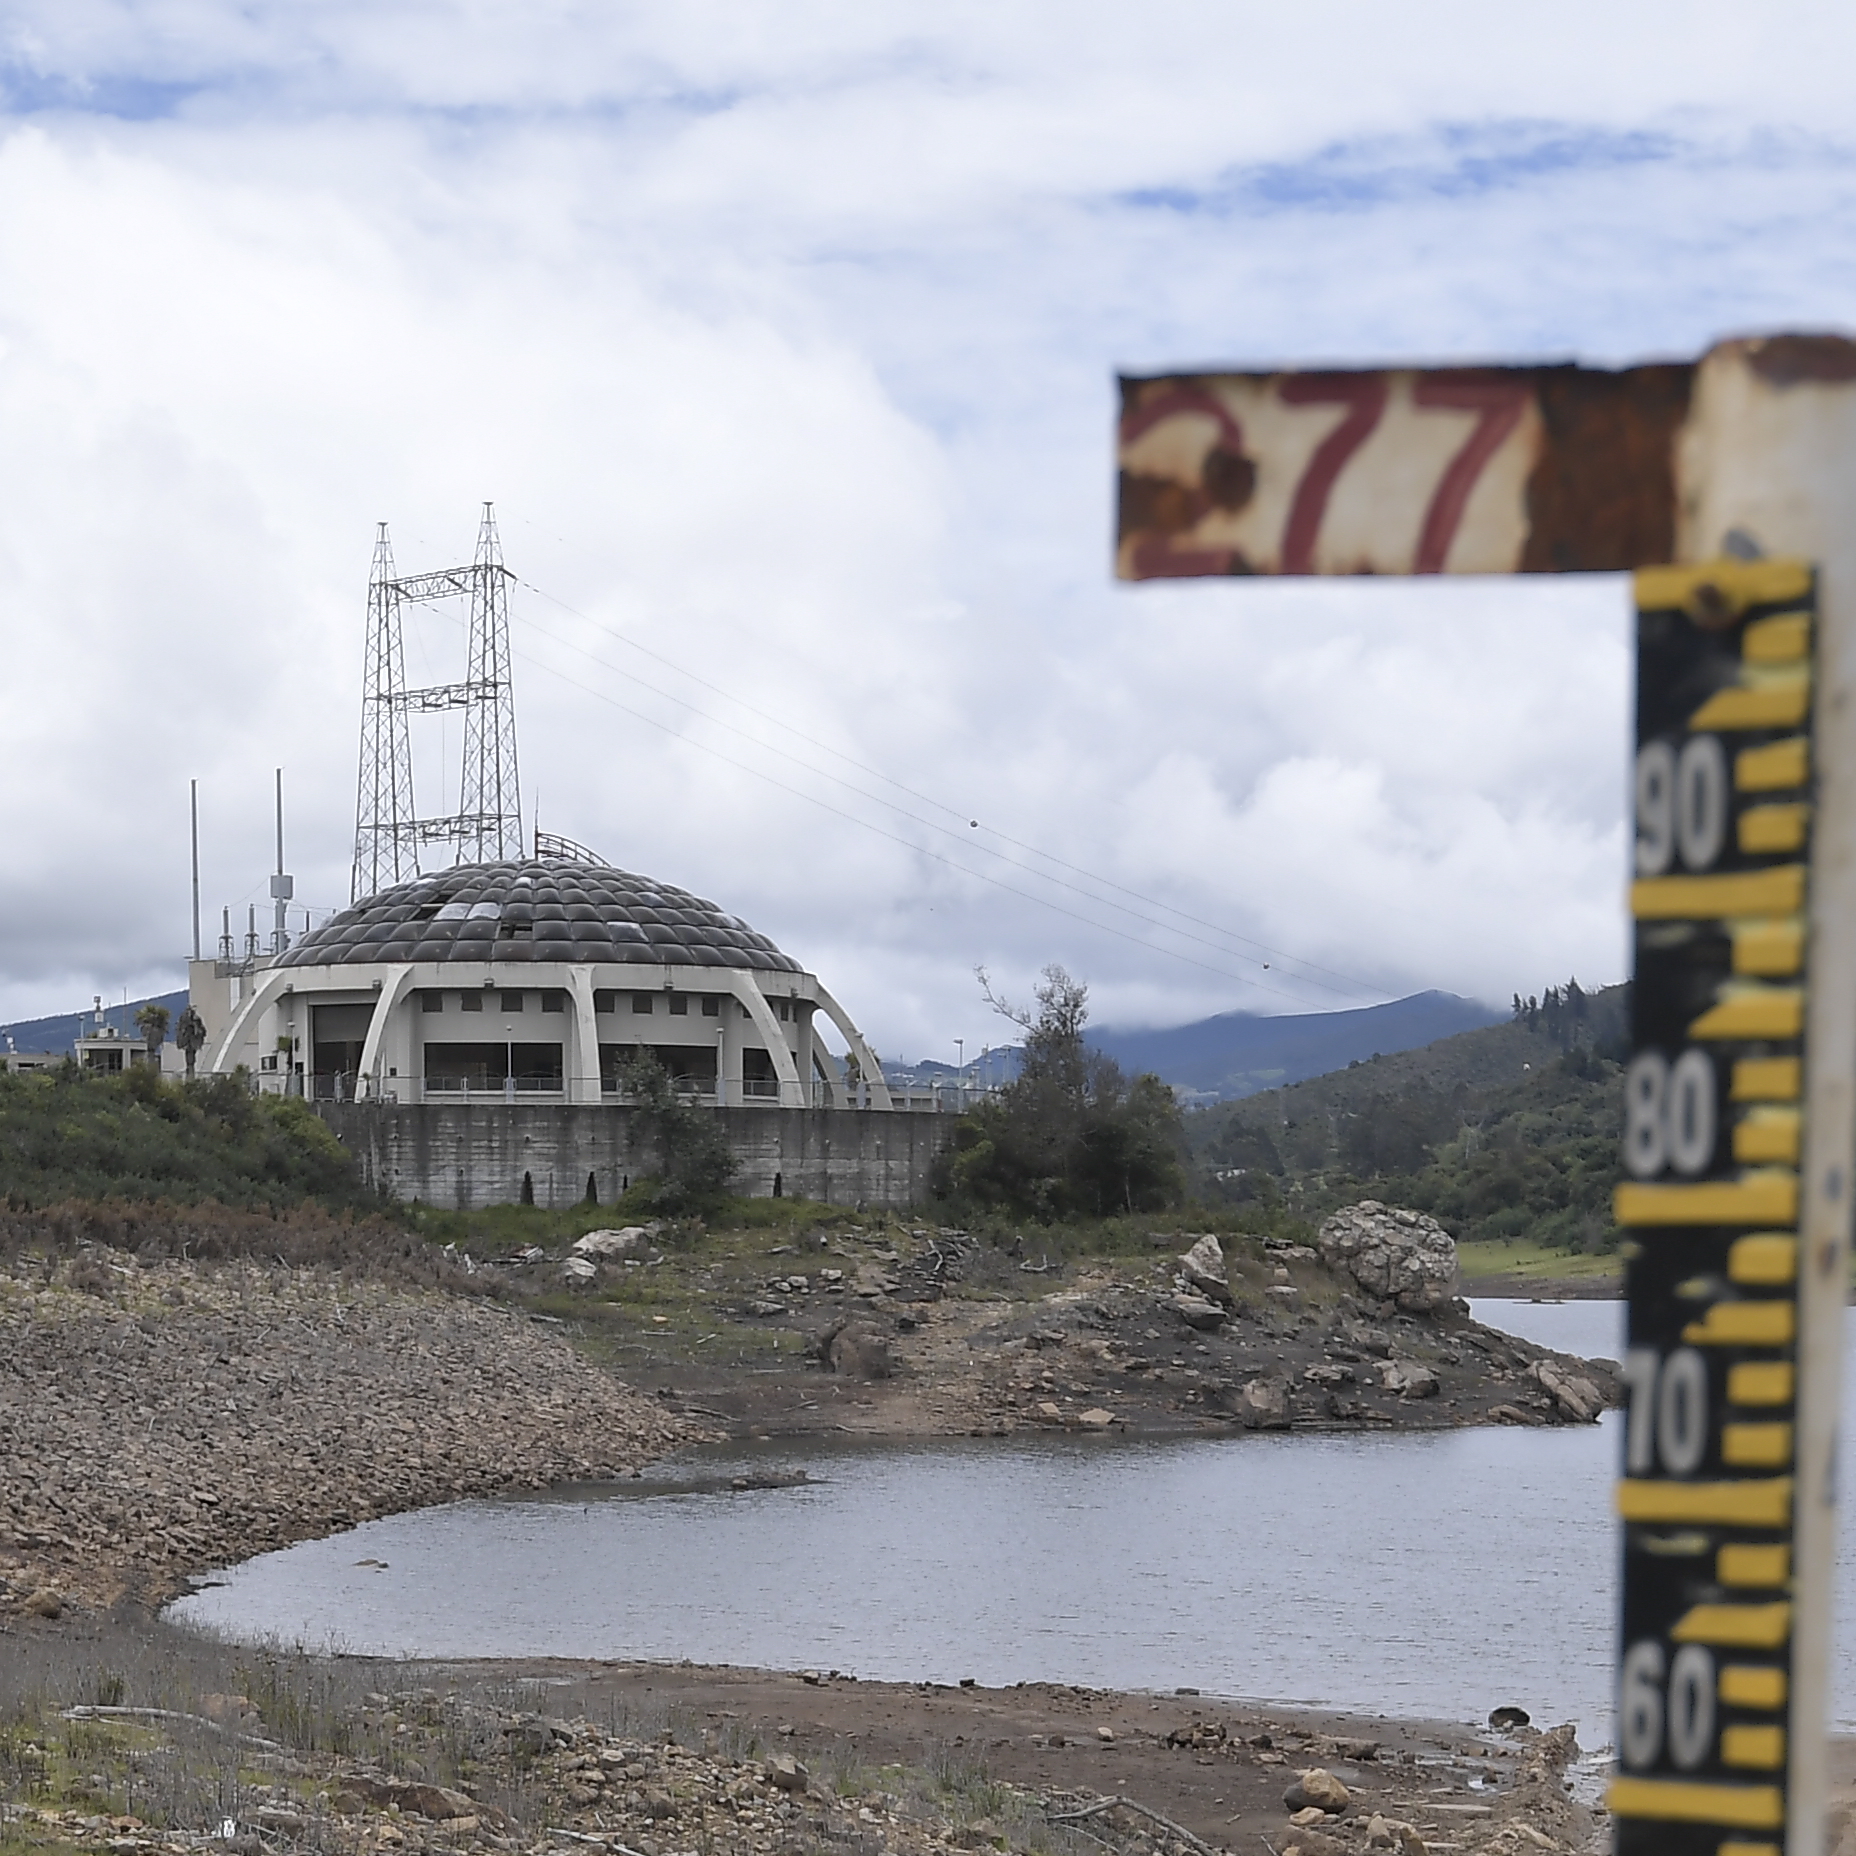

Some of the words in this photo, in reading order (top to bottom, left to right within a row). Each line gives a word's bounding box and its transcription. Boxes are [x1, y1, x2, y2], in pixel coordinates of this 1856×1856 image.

[1637, 733, 1726, 874] 90
[1626, 1048, 1715, 1175] 80
[1620, 1638, 1715, 1770] 60
